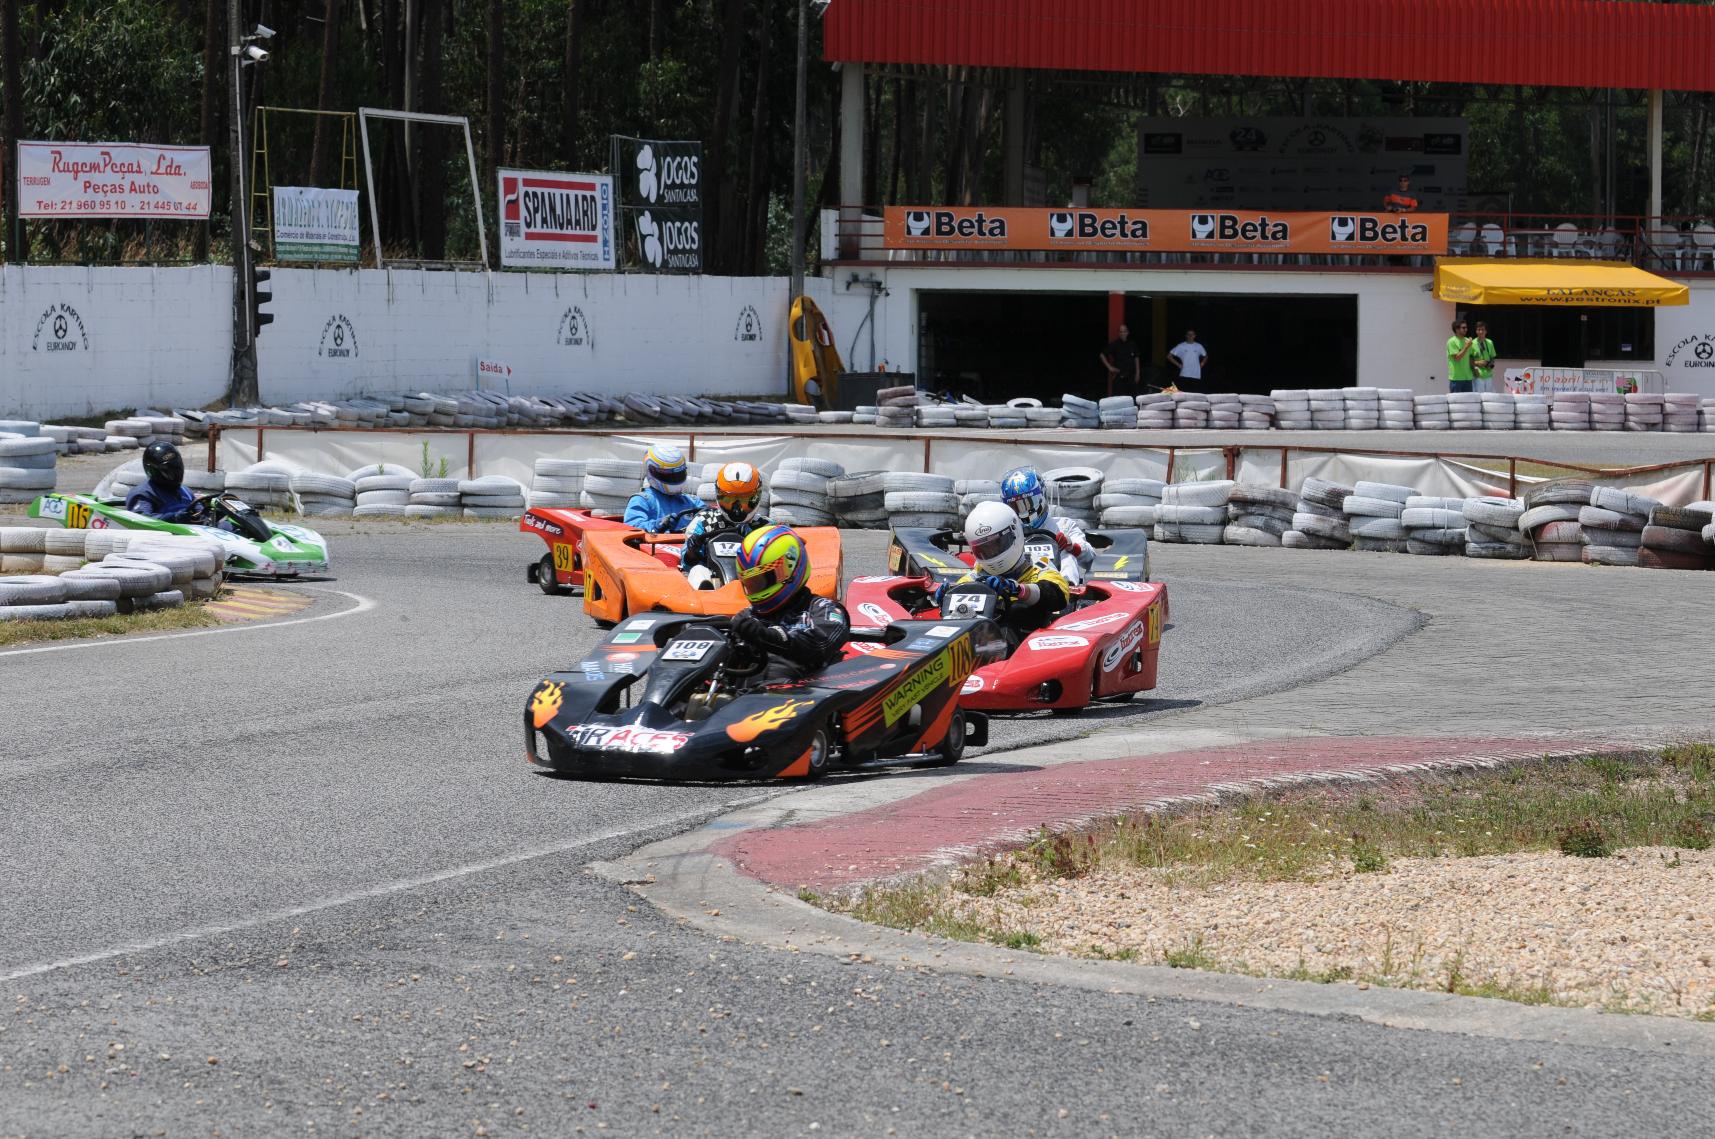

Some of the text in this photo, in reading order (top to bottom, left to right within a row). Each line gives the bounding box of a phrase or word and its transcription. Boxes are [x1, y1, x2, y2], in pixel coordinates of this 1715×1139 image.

[151, 153, 187, 177] Lda.
[660, 155, 699, 195] JOGOS
[83, 180, 160, 197] Peças Auto
[36, 200, 58, 211] Tel:
[61, 200, 73, 210] 21
[77, 200, 96, 210] 960
[99, 200, 111, 210] 95
[115, 200, 126, 210] 10
[140, 201, 151, 211] 21
[154, 200, 171, 211] 445
[185, 202, 198, 211] 44
[523, 190, 598, 232] SPANJAARD
[936, 212, 1006, 237] Beta
[1079, 213, 1148, 239] Beta
[1218, 215, 1288, 241] Beta
[1359, 217, 1427, 242] Beta
[662, 221, 699, 260] JOGOS
[33, 303, 89, 351] ESCOLA KARTING
[1665, 335, 1698, 367] ESCOLA
[545, 524, 562, 535] more
[556, 545, 569, 569] 39
[720, 542, 736, 550] 17
[955, 594, 981, 603] 74
[674, 641, 710, 650] 108
[949, 636, 973, 681] 108
[885, 657, 944, 710] WARNING
